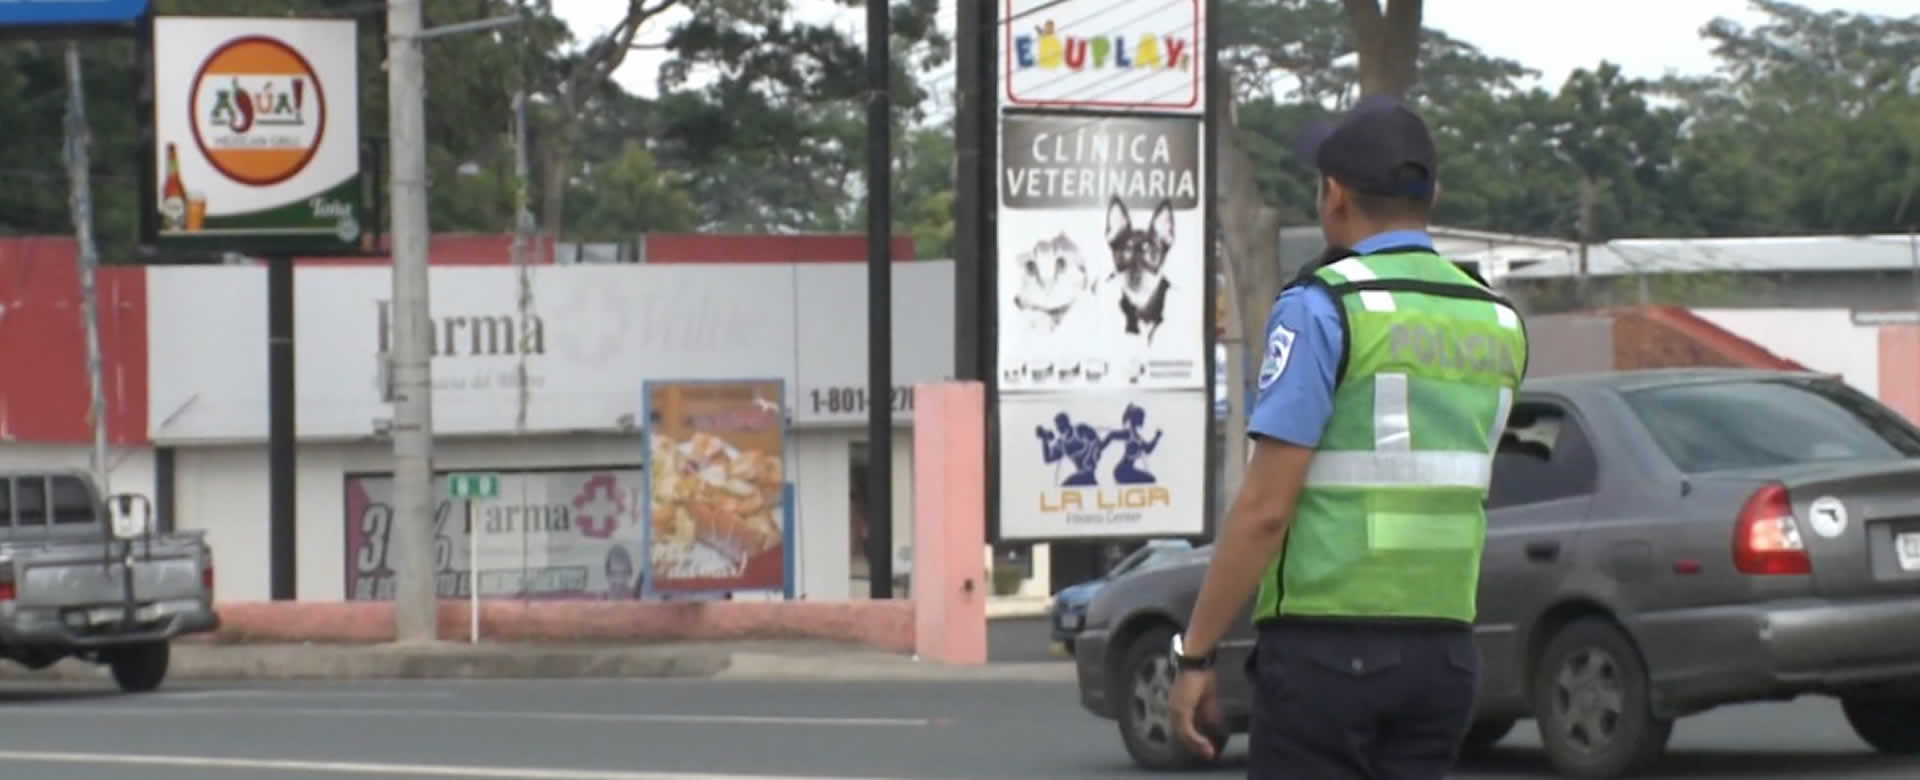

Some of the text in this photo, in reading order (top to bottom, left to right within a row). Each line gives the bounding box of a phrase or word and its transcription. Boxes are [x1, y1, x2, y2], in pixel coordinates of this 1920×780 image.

[1014, 27, 1187, 70] EDUPLAY
[1032, 128, 1170, 163] CLÍNICA
[1006, 167, 1196, 198] VETERINARIA
[1039, 487, 1170, 512] LA LIGA
